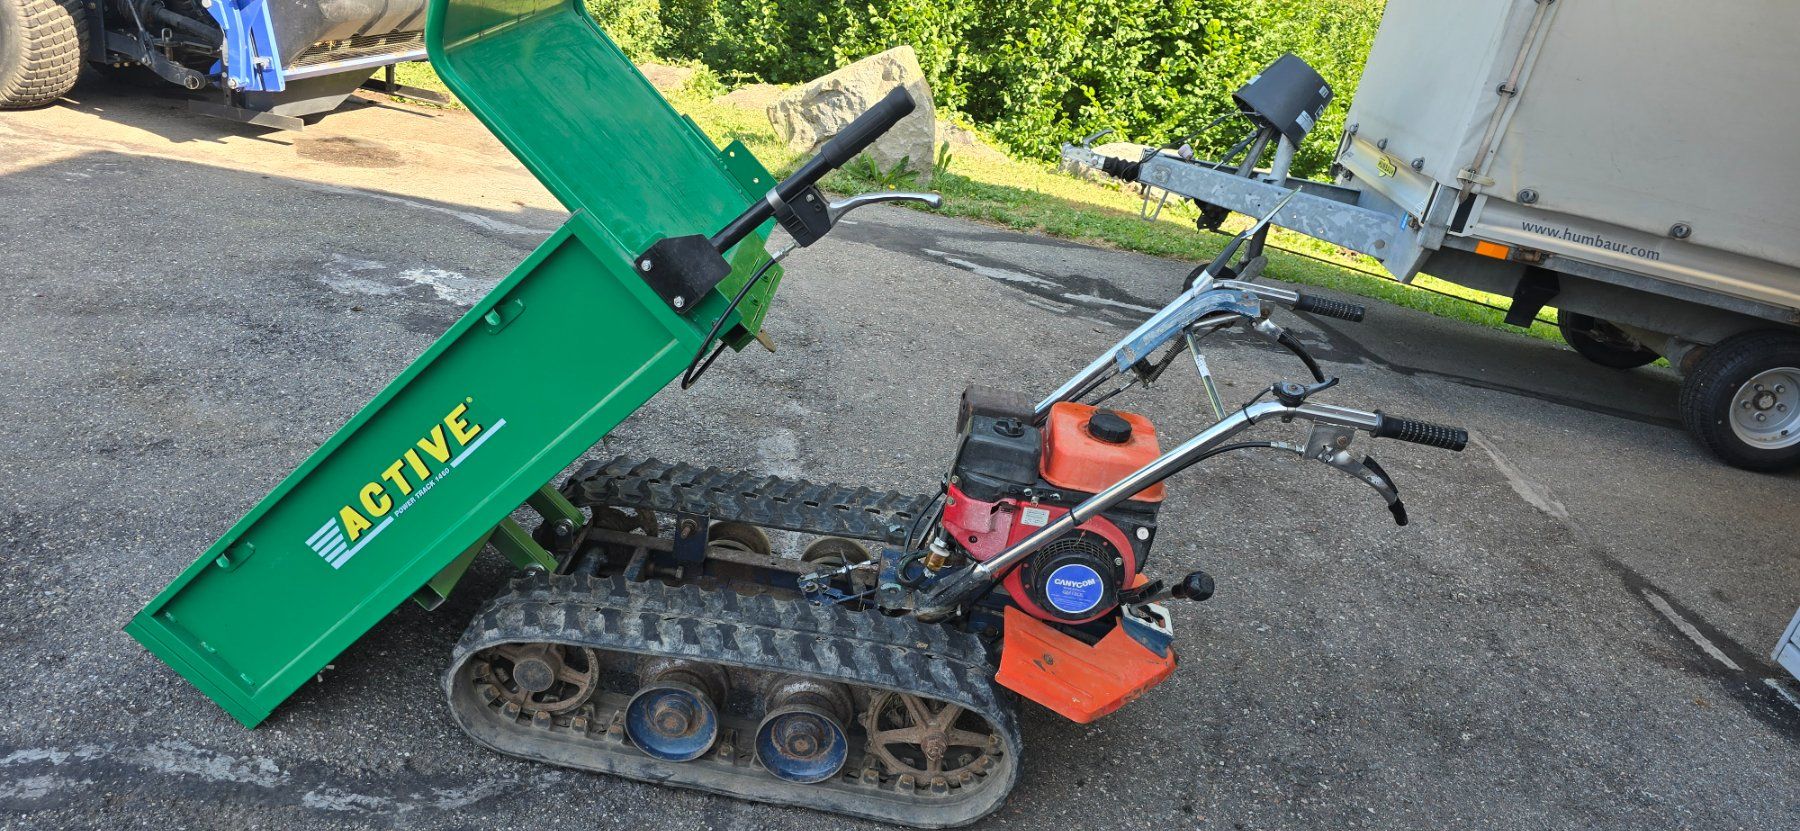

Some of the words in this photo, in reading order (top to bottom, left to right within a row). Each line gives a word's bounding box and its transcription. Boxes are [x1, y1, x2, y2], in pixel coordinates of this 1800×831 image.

[1522, 221, 1660, 261] www.humbaur.com
[339, 403, 483, 542] ACTIVE
[394, 497, 416, 517] POWER
[415, 480, 436, 499] TRACK
[1054, 578, 1096, 588] CANYCOM
